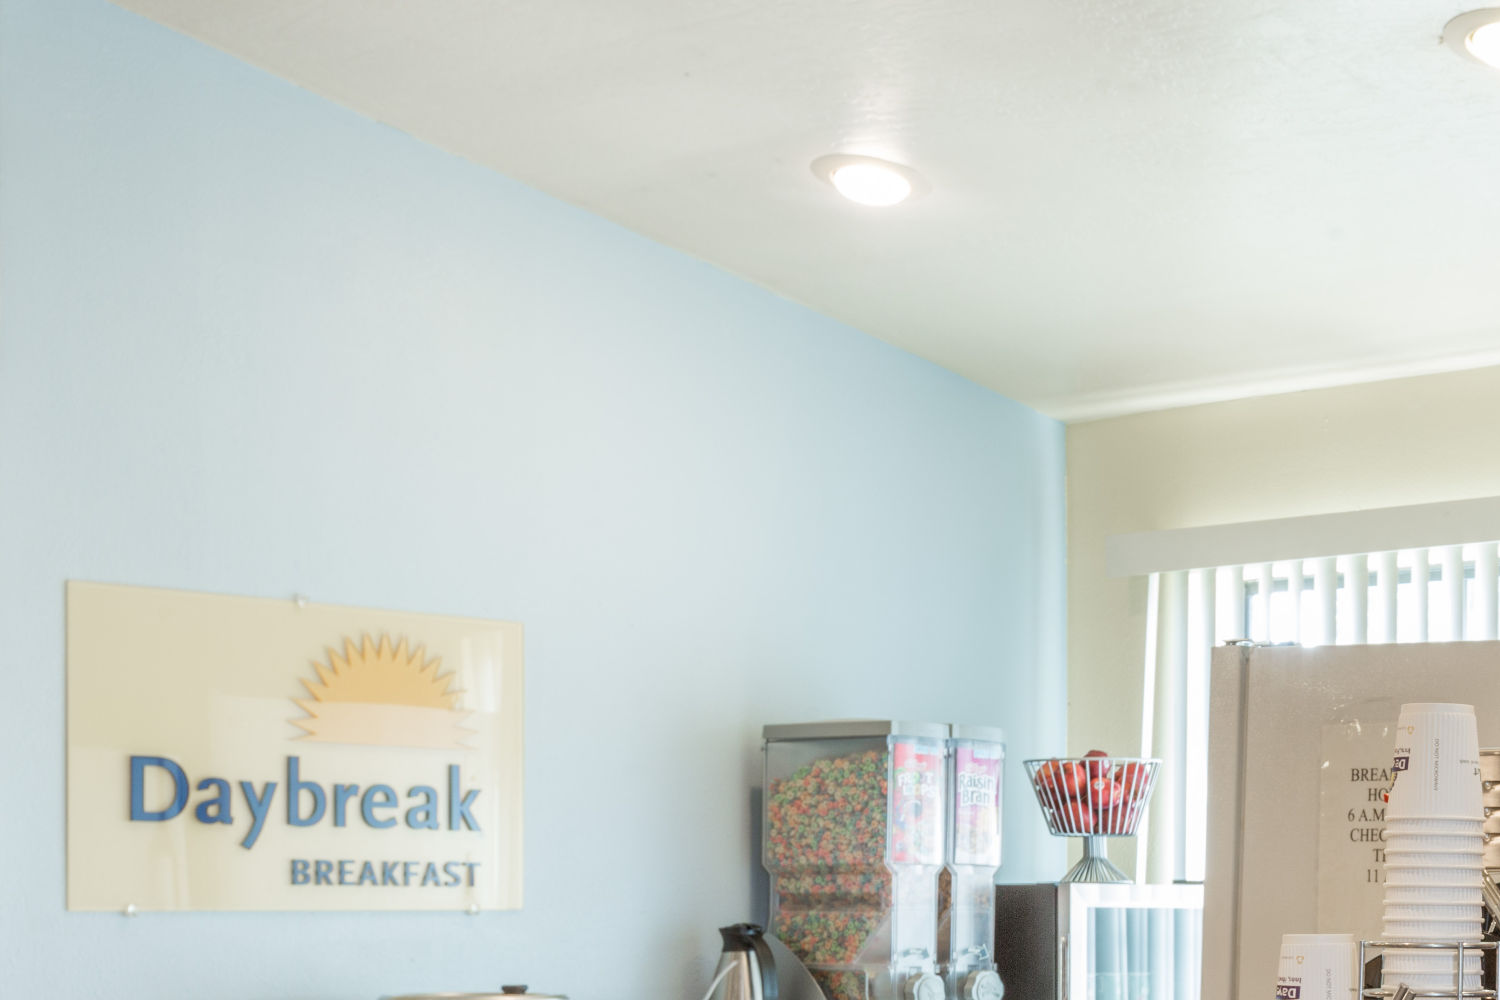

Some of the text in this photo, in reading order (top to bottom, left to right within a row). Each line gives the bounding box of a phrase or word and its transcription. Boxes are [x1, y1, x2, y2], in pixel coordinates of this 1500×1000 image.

[958, 773, 994, 791] Raisin
[129, 755, 481, 850] Daybreak
[962, 788, 992, 804] Bran
[1347, 808, 1356, 822] 6
[1350, 828, 1387, 842] CHEC
[290, 859, 482, 887] BREAKFAST
